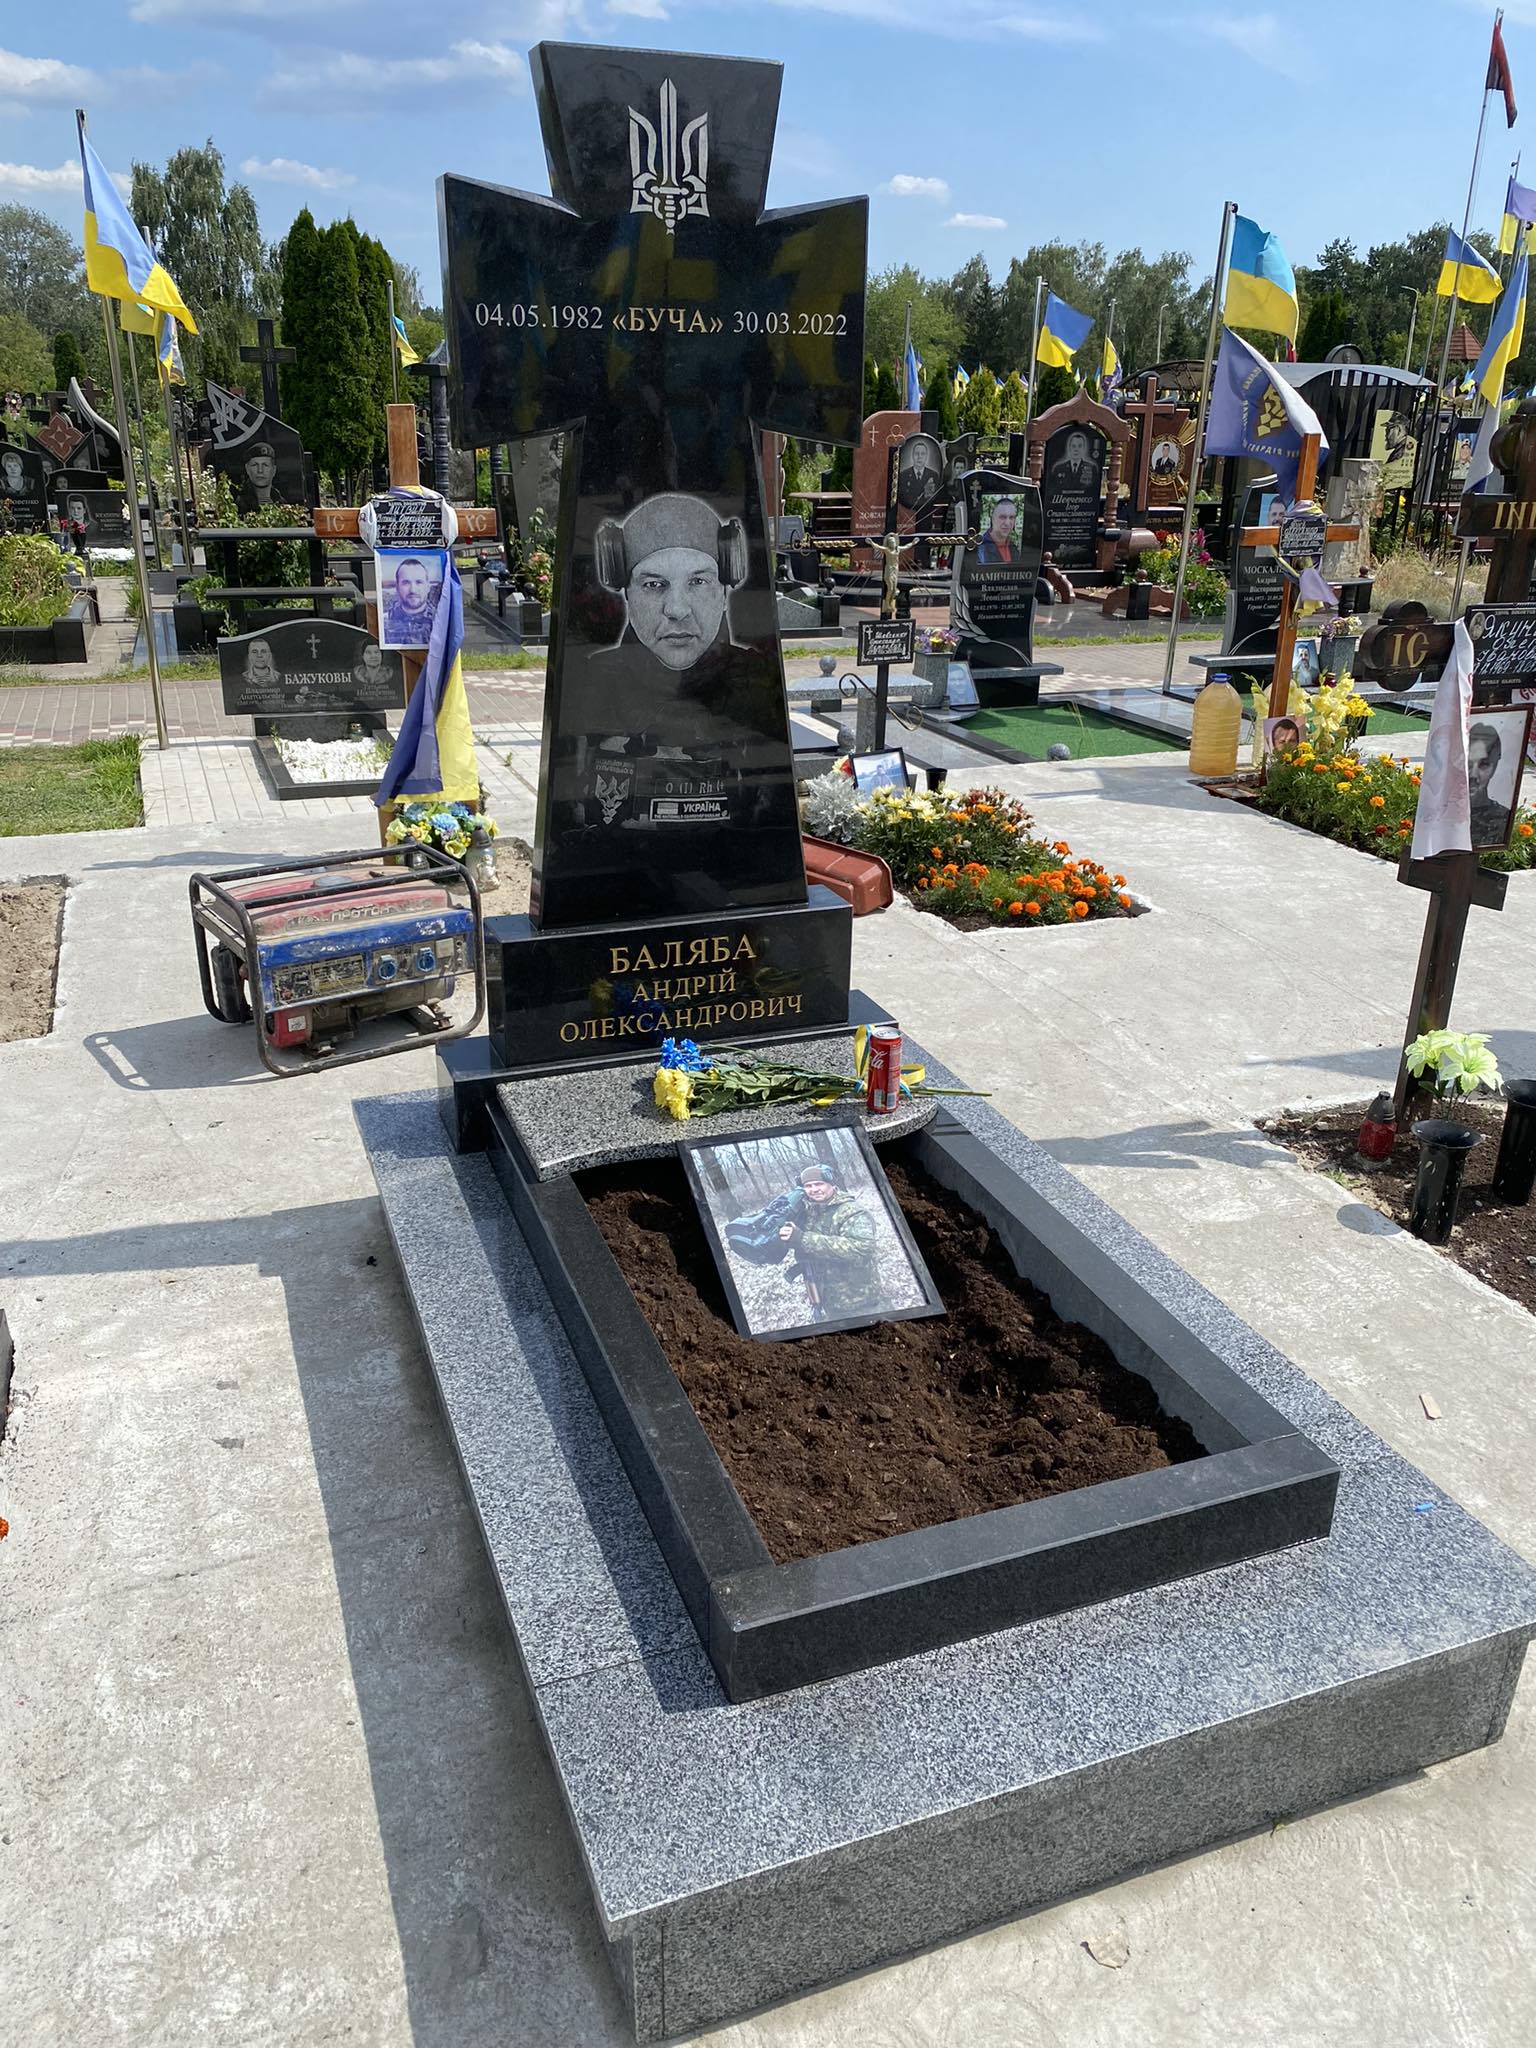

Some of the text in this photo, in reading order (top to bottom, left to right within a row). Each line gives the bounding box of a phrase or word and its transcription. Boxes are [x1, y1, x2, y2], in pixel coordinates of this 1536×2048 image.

[475, 303, 847, 336] 04.05.1982 «БУЧА» 30.03.2022
[284, 673, 352, 685] БАЖУКОВЫ
[683, 800, 721, 812] УКРАЇНА
[609, 933, 757, 974] БАЛЯБА
[631, 967, 737, 1003] АНДРІЙ
[559, 993, 804, 1043] ОЛЕКСАНДРОВИЧ
